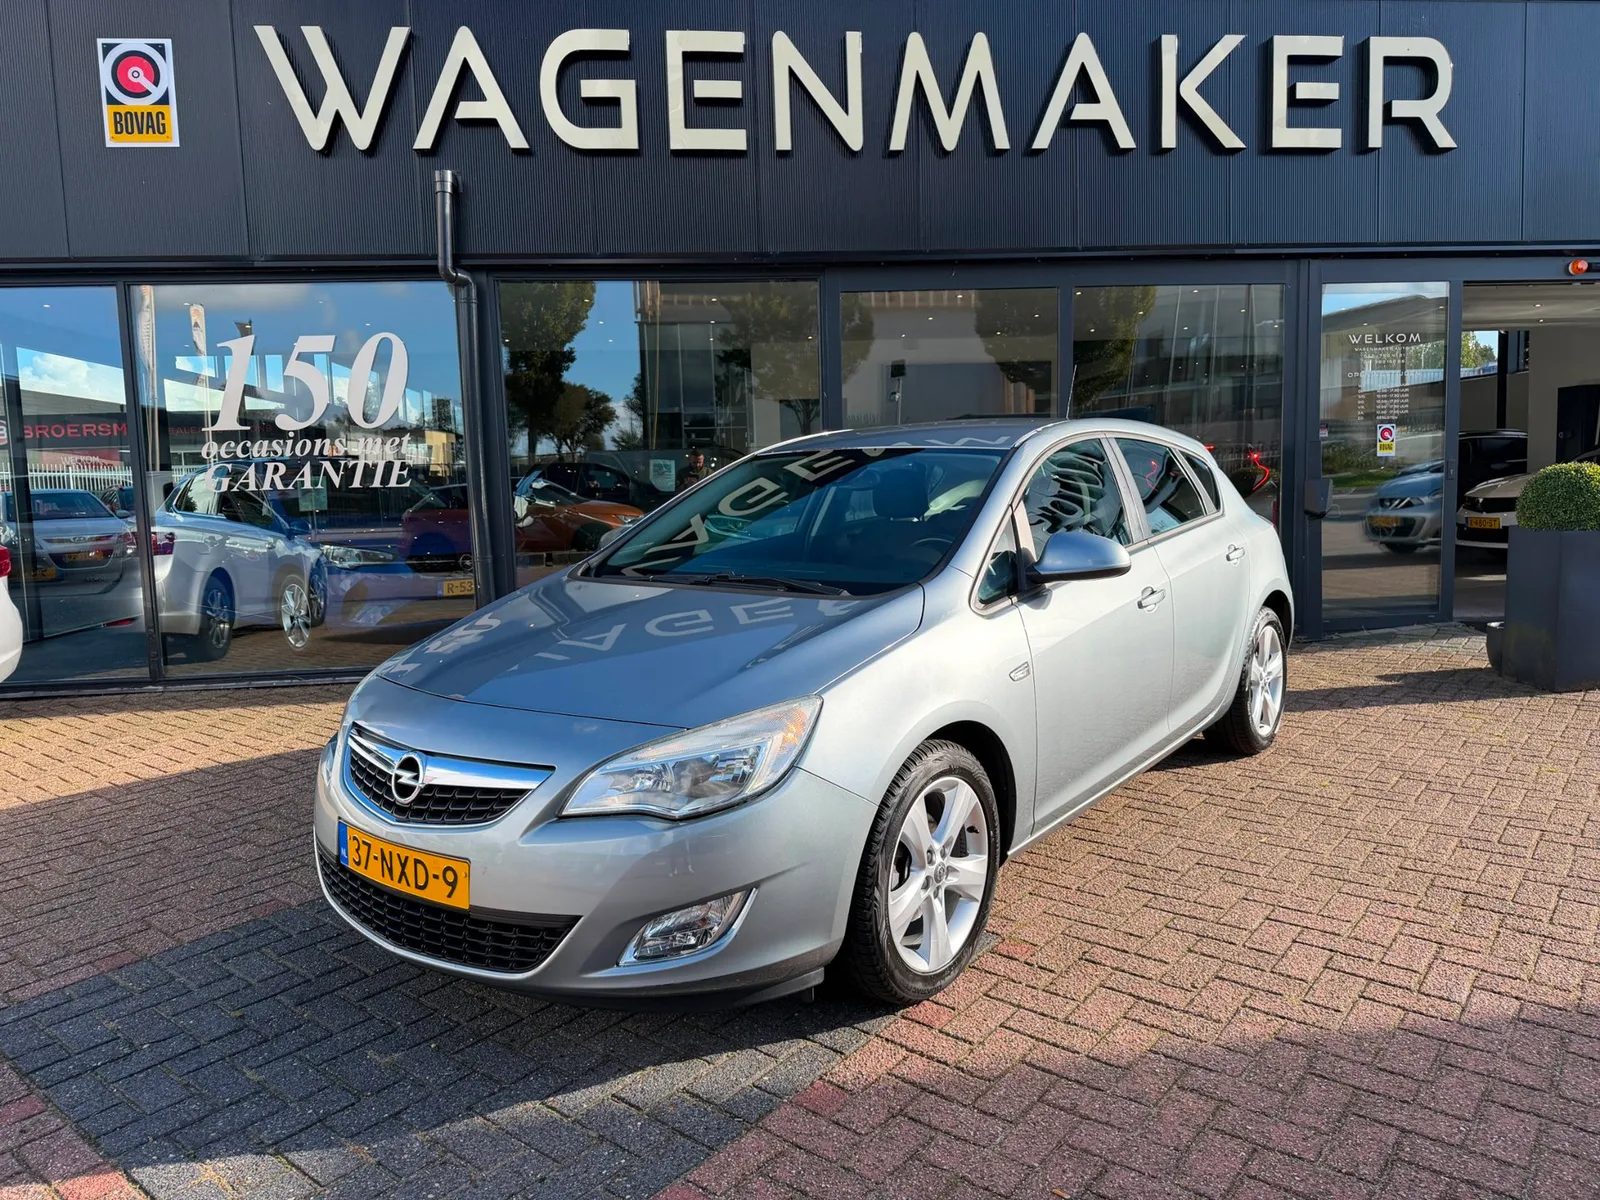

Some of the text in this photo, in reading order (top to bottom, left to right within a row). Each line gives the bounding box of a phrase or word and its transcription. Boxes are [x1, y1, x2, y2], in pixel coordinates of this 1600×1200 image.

[253, 25, 1458, 152] WAGENMAKER
[113, 111, 166, 135] BOVAG
[1348, 333, 1421, 344] WELKOM
[202, 332, 409, 431] 150
[201, 431, 411, 459] occasions met
[204, 459, 414, 493] GARANTIE
[352, 835, 458, 898] 37-NXD-9
